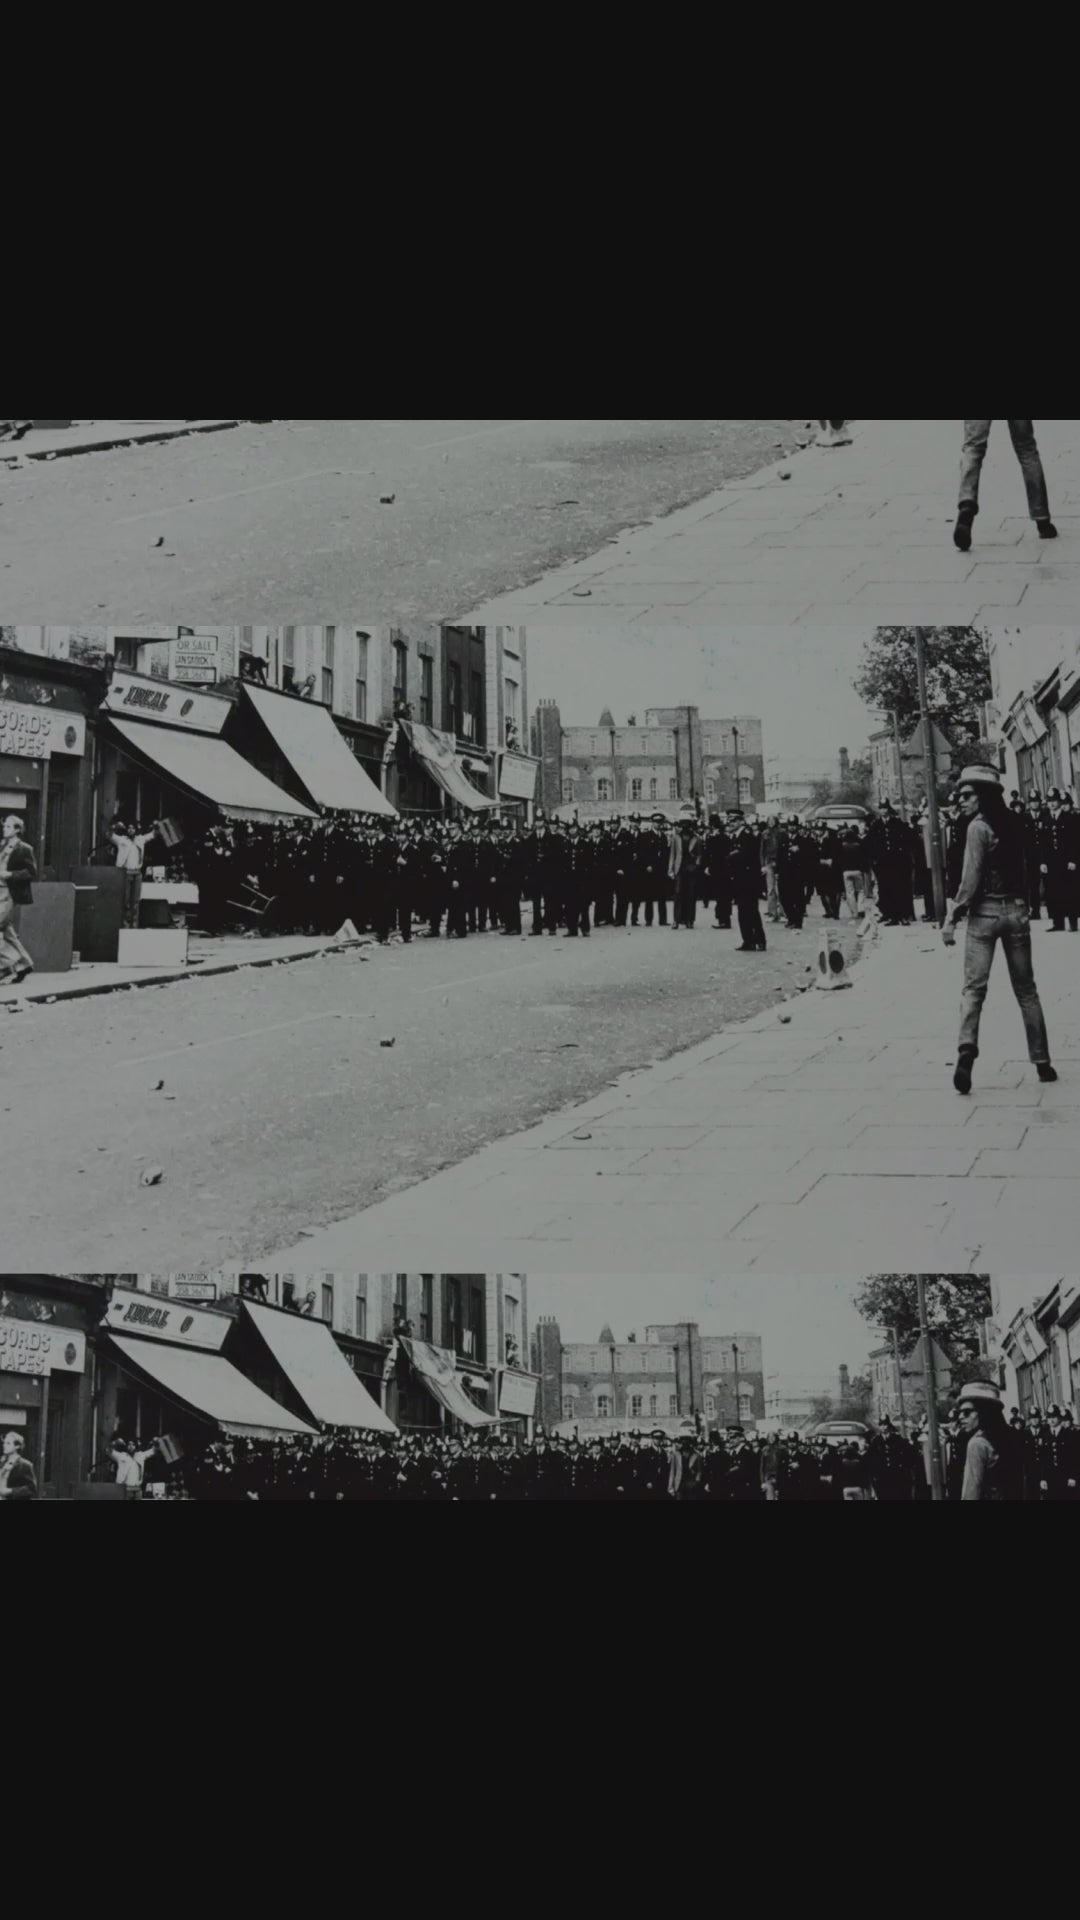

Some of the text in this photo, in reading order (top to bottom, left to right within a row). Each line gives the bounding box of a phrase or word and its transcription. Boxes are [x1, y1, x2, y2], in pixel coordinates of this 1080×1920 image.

[177, 640, 211, 651] OR SALE
[123, 685, 171, 712] IDEAL
[0, 732, 46, 757] TAPES
[123, 1302, 171, 1329] IDEAL
[0, 1349, 46, 1374] TAPES
